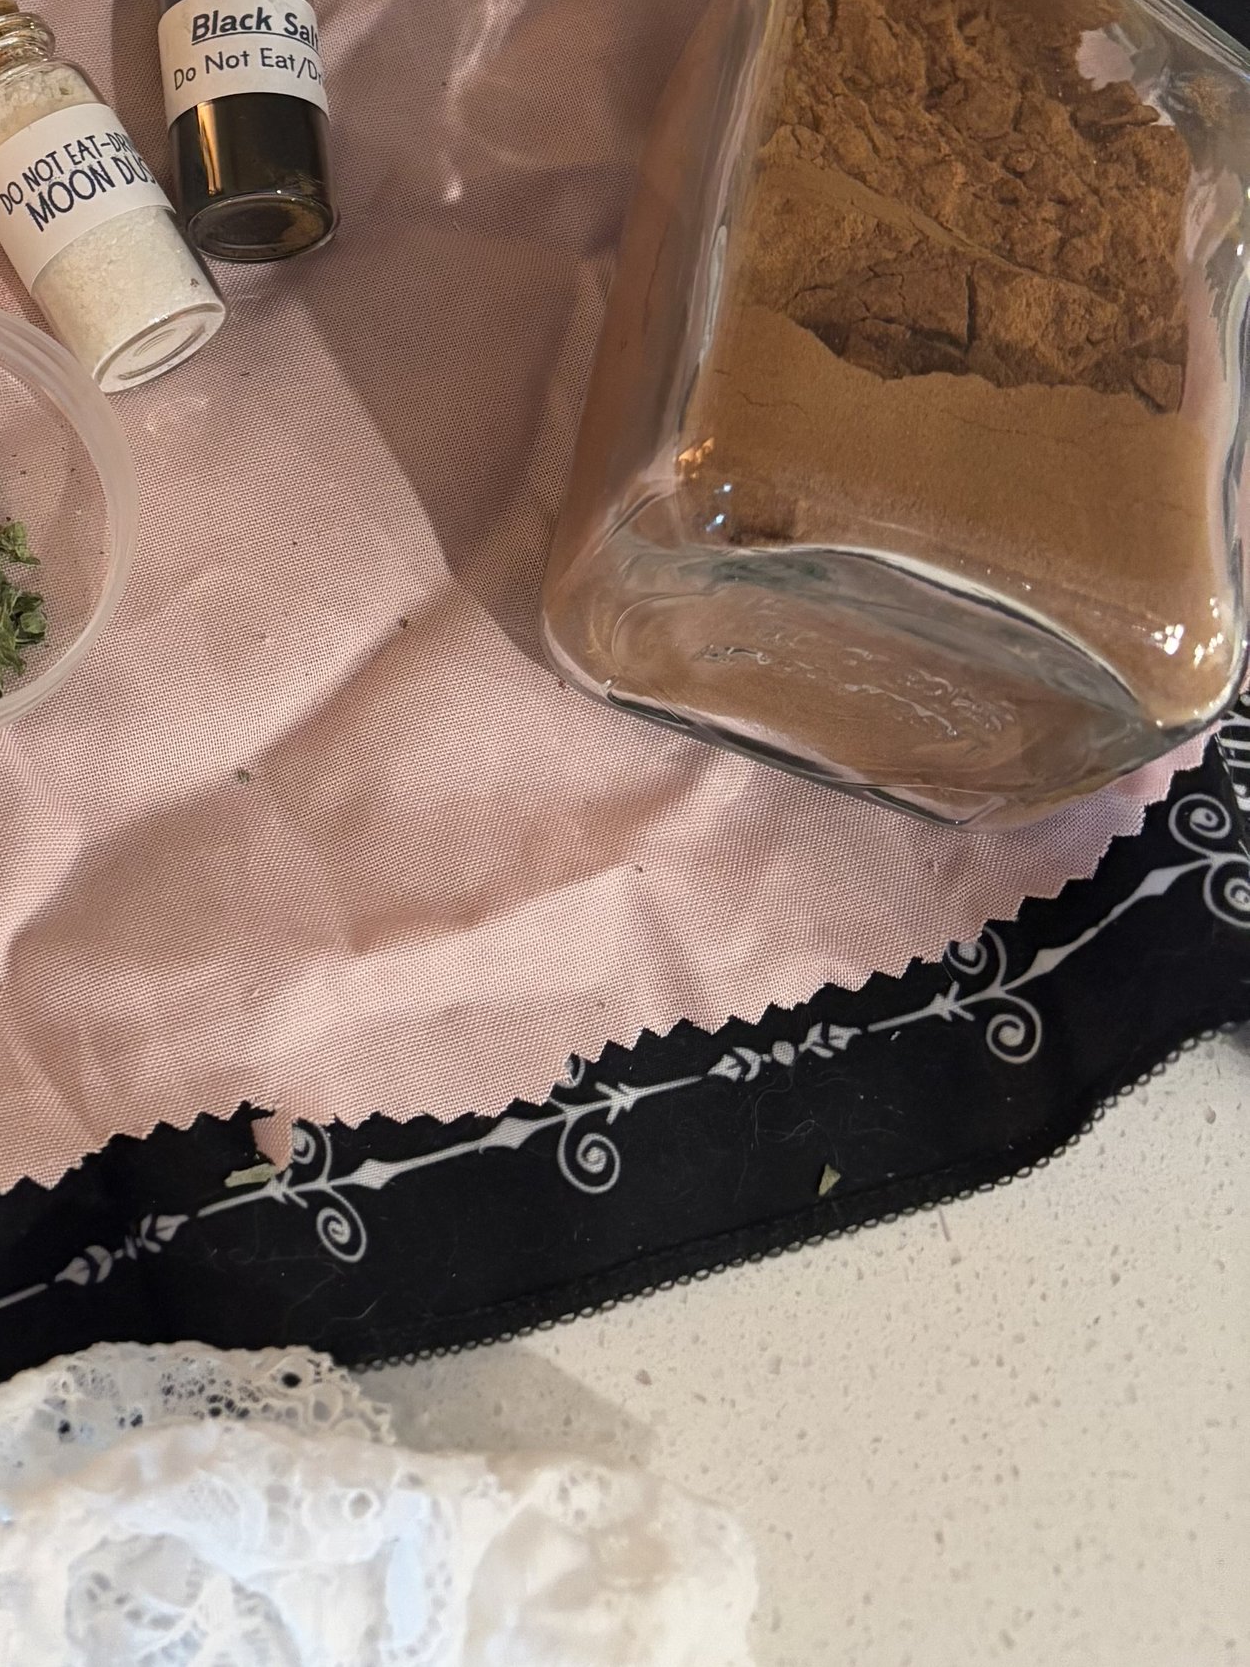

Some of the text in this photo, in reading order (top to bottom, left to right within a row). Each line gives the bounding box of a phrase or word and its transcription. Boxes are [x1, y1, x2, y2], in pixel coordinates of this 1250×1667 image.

[191, 6, 272, 42] Black
[173, 66, 196, 90] Do
[204, 49, 250, 74] Not
[22, 151, 65, 189] NOT
[63, 132, 136, 166] EAT-DR
[25, 162, 116, 232] MOON
